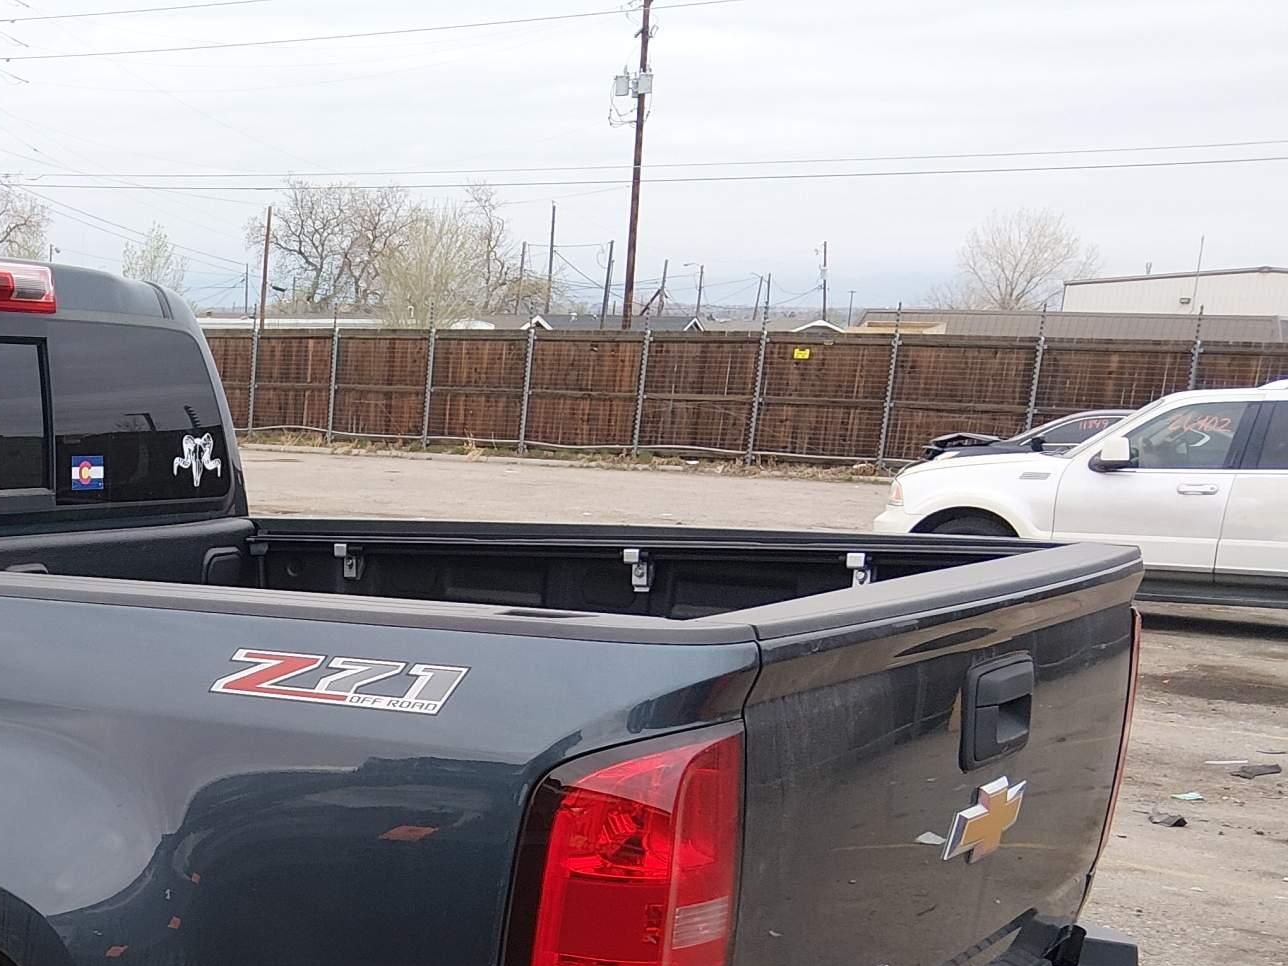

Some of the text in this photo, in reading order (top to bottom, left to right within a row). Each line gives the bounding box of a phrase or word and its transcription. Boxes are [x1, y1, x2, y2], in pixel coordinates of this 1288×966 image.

[210, 648, 470, 704] Z71
[348, 695, 439, 713] OFF ROAD
